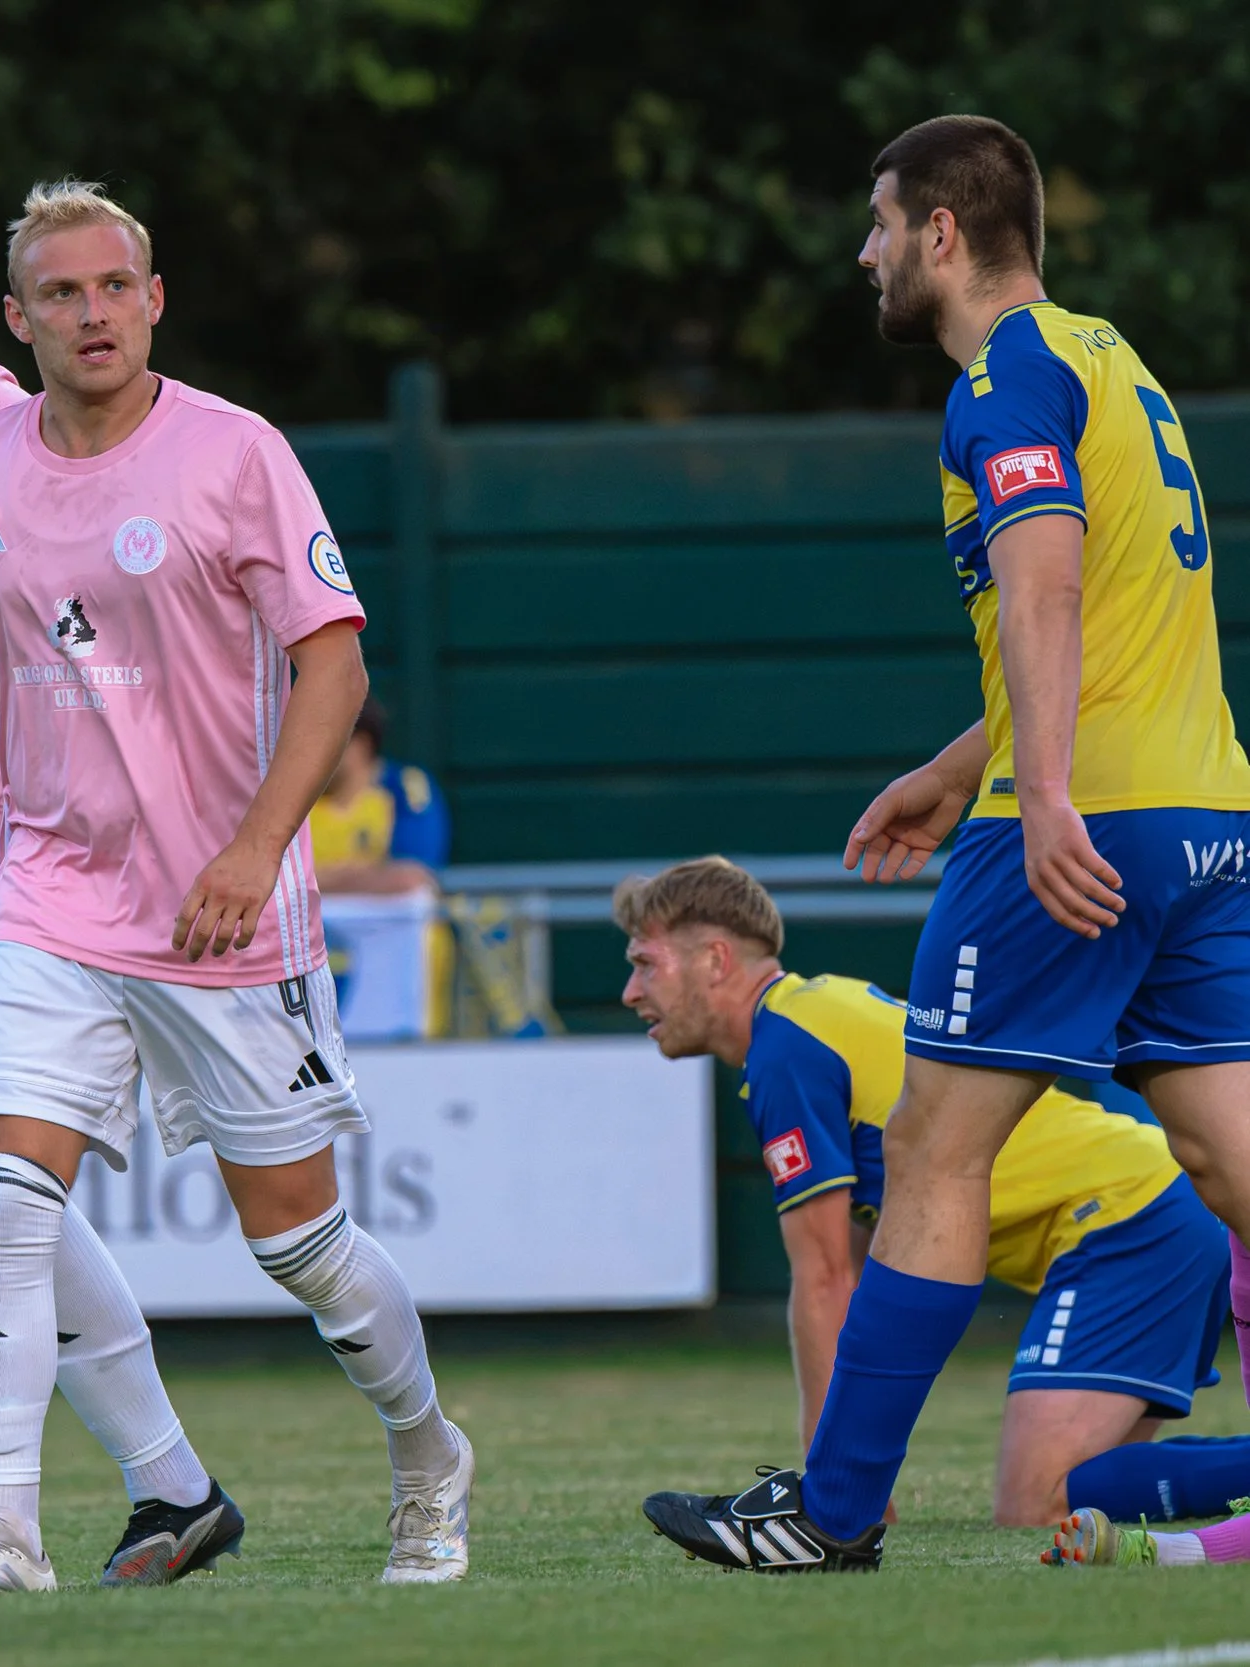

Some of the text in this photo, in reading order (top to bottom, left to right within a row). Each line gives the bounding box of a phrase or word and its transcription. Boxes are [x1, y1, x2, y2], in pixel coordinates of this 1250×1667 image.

[1070, 326, 1126, 356] NO
[1000, 454, 1047, 476] PITCHING
[1135, 385, 1209, 571] 5
[325, 551, 345, 574] B
[80, 665, 143, 685] STEELS
[54, 688, 78, 708] UK
